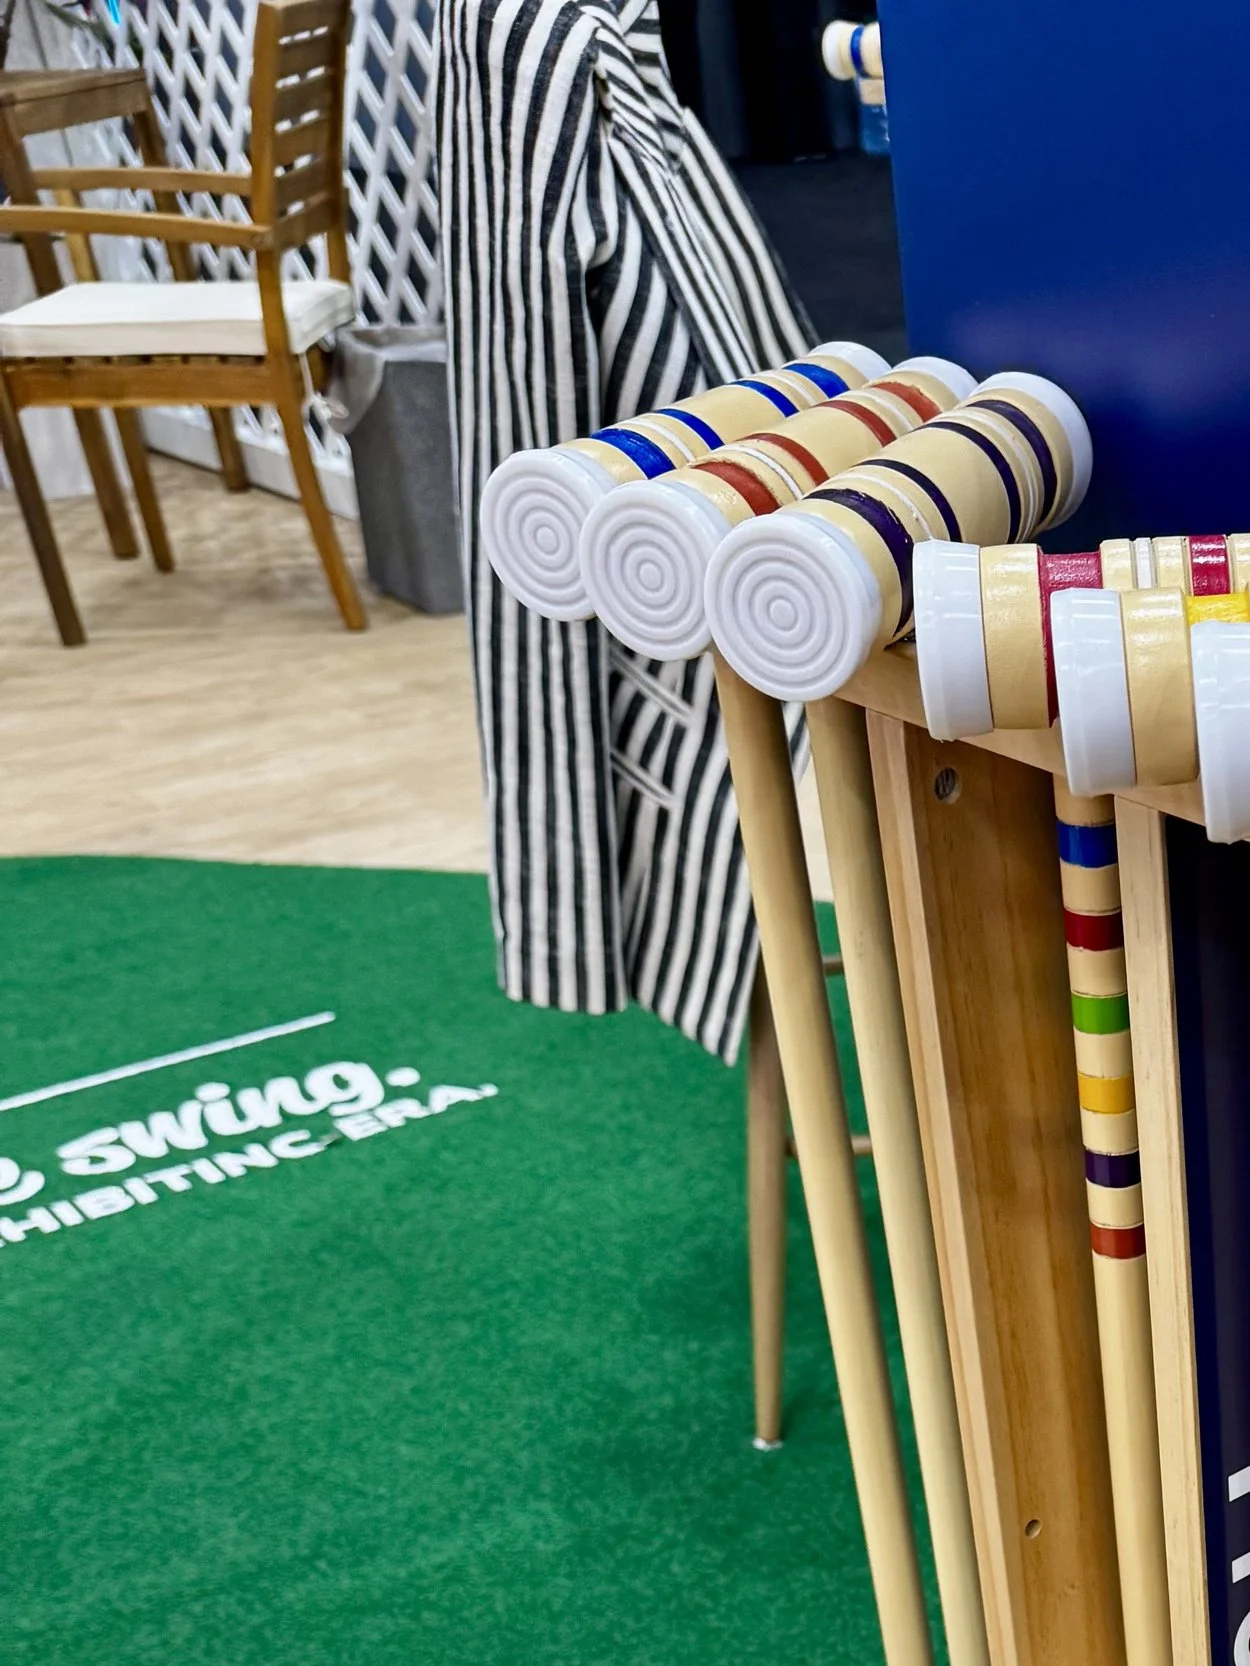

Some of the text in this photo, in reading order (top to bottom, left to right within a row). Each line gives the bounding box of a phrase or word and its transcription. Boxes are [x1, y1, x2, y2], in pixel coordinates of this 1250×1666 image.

[0, 1129, 326, 1249] HIBITING
[333, 1083, 499, 1141] ERA.
[56, 1061, 420, 1175] swing.
